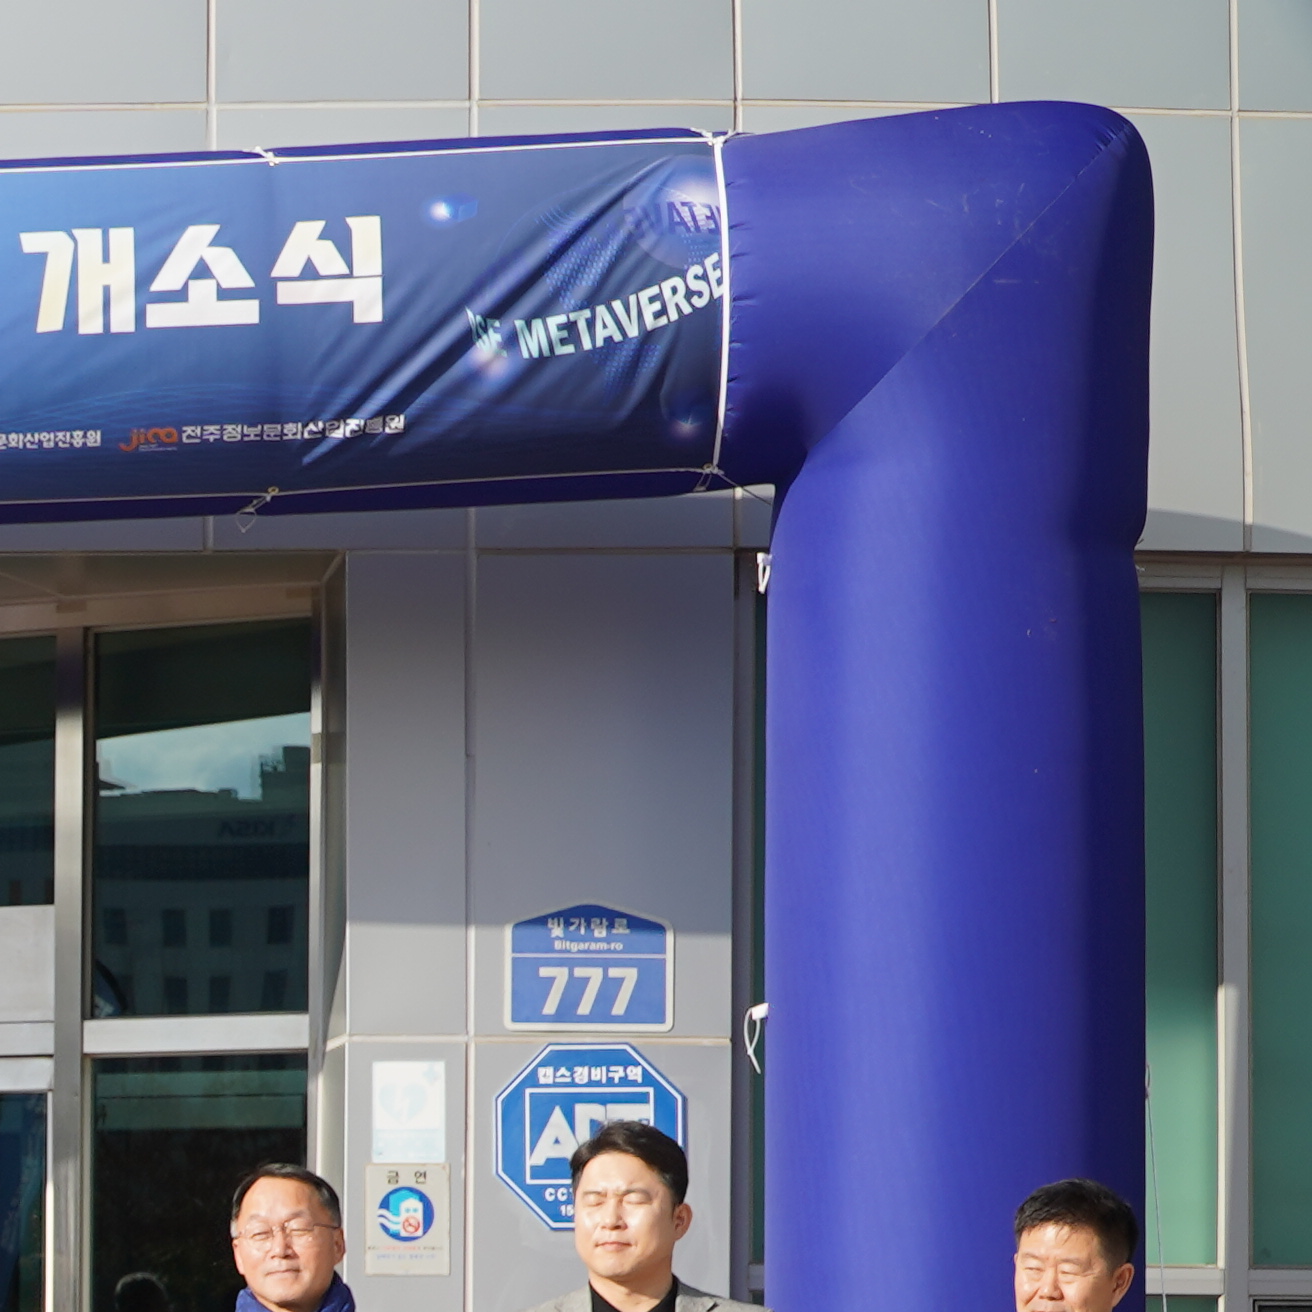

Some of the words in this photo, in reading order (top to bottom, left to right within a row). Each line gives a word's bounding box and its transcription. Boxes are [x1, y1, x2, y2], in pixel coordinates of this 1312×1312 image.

[20, 215, 385, 334] 개소식
[514, 252, 724, 359] METAVERSE
[181, 414, 406, 444] 전주정보문화산업진흥원
[547, 917, 631, 938] 빛가람로
[553, 939, 624, 952] Bitgaram-ro
[538, 966, 639, 1016] 777
[537, 1065, 644, 1084] 캡스경비구역
[544, 1187, 576, 1202] CC
